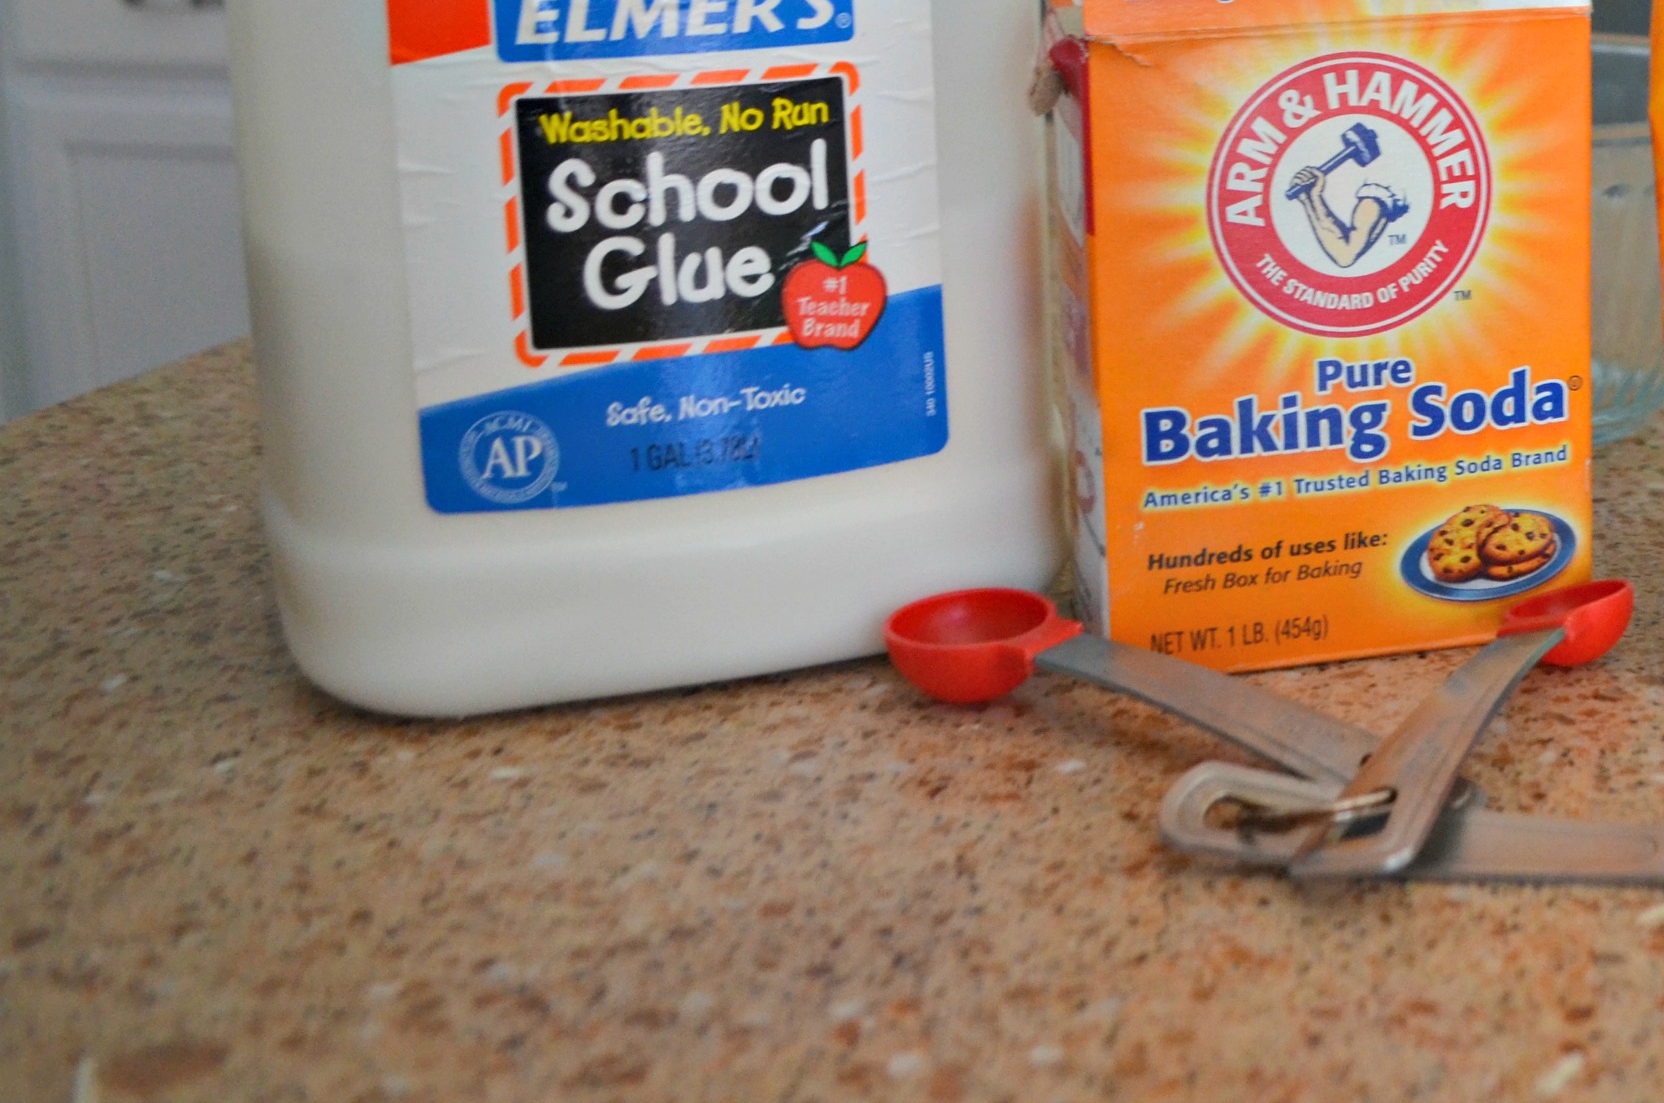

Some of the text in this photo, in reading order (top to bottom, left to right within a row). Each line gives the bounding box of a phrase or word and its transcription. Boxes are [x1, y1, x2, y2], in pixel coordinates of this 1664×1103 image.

[538, 100, 830, 145] Washable, No Run
[1226, 69, 1477, 227] ARM & HAMMER
[546, 137, 832, 234] School
[583, 232, 775, 310] Glue
[822, 276, 848, 295] #1
[1256, 239, 1450, 311] THE STANDARD OF PURITY
[796, 295, 872, 317] Teacher
[802, 318, 862, 338] Brand
[1317, 357, 1413, 393] Pure
[678, 383, 807, 420] Non-Toxic
[1143, 366, 1567, 463] Baking Soda
[481, 435, 543, 478] AP
[648, 442, 691, 471] GAL
[1144, 443, 1568, 509] America's #1 Trusted Baking Soda Brand
[1147, 530, 1390, 573] Hundreds of uses like:
[1163, 558, 1363, 595] Fresh Box for Baking
[1150, 613, 1330, 656] NET WT. 1 LB. (454g)
